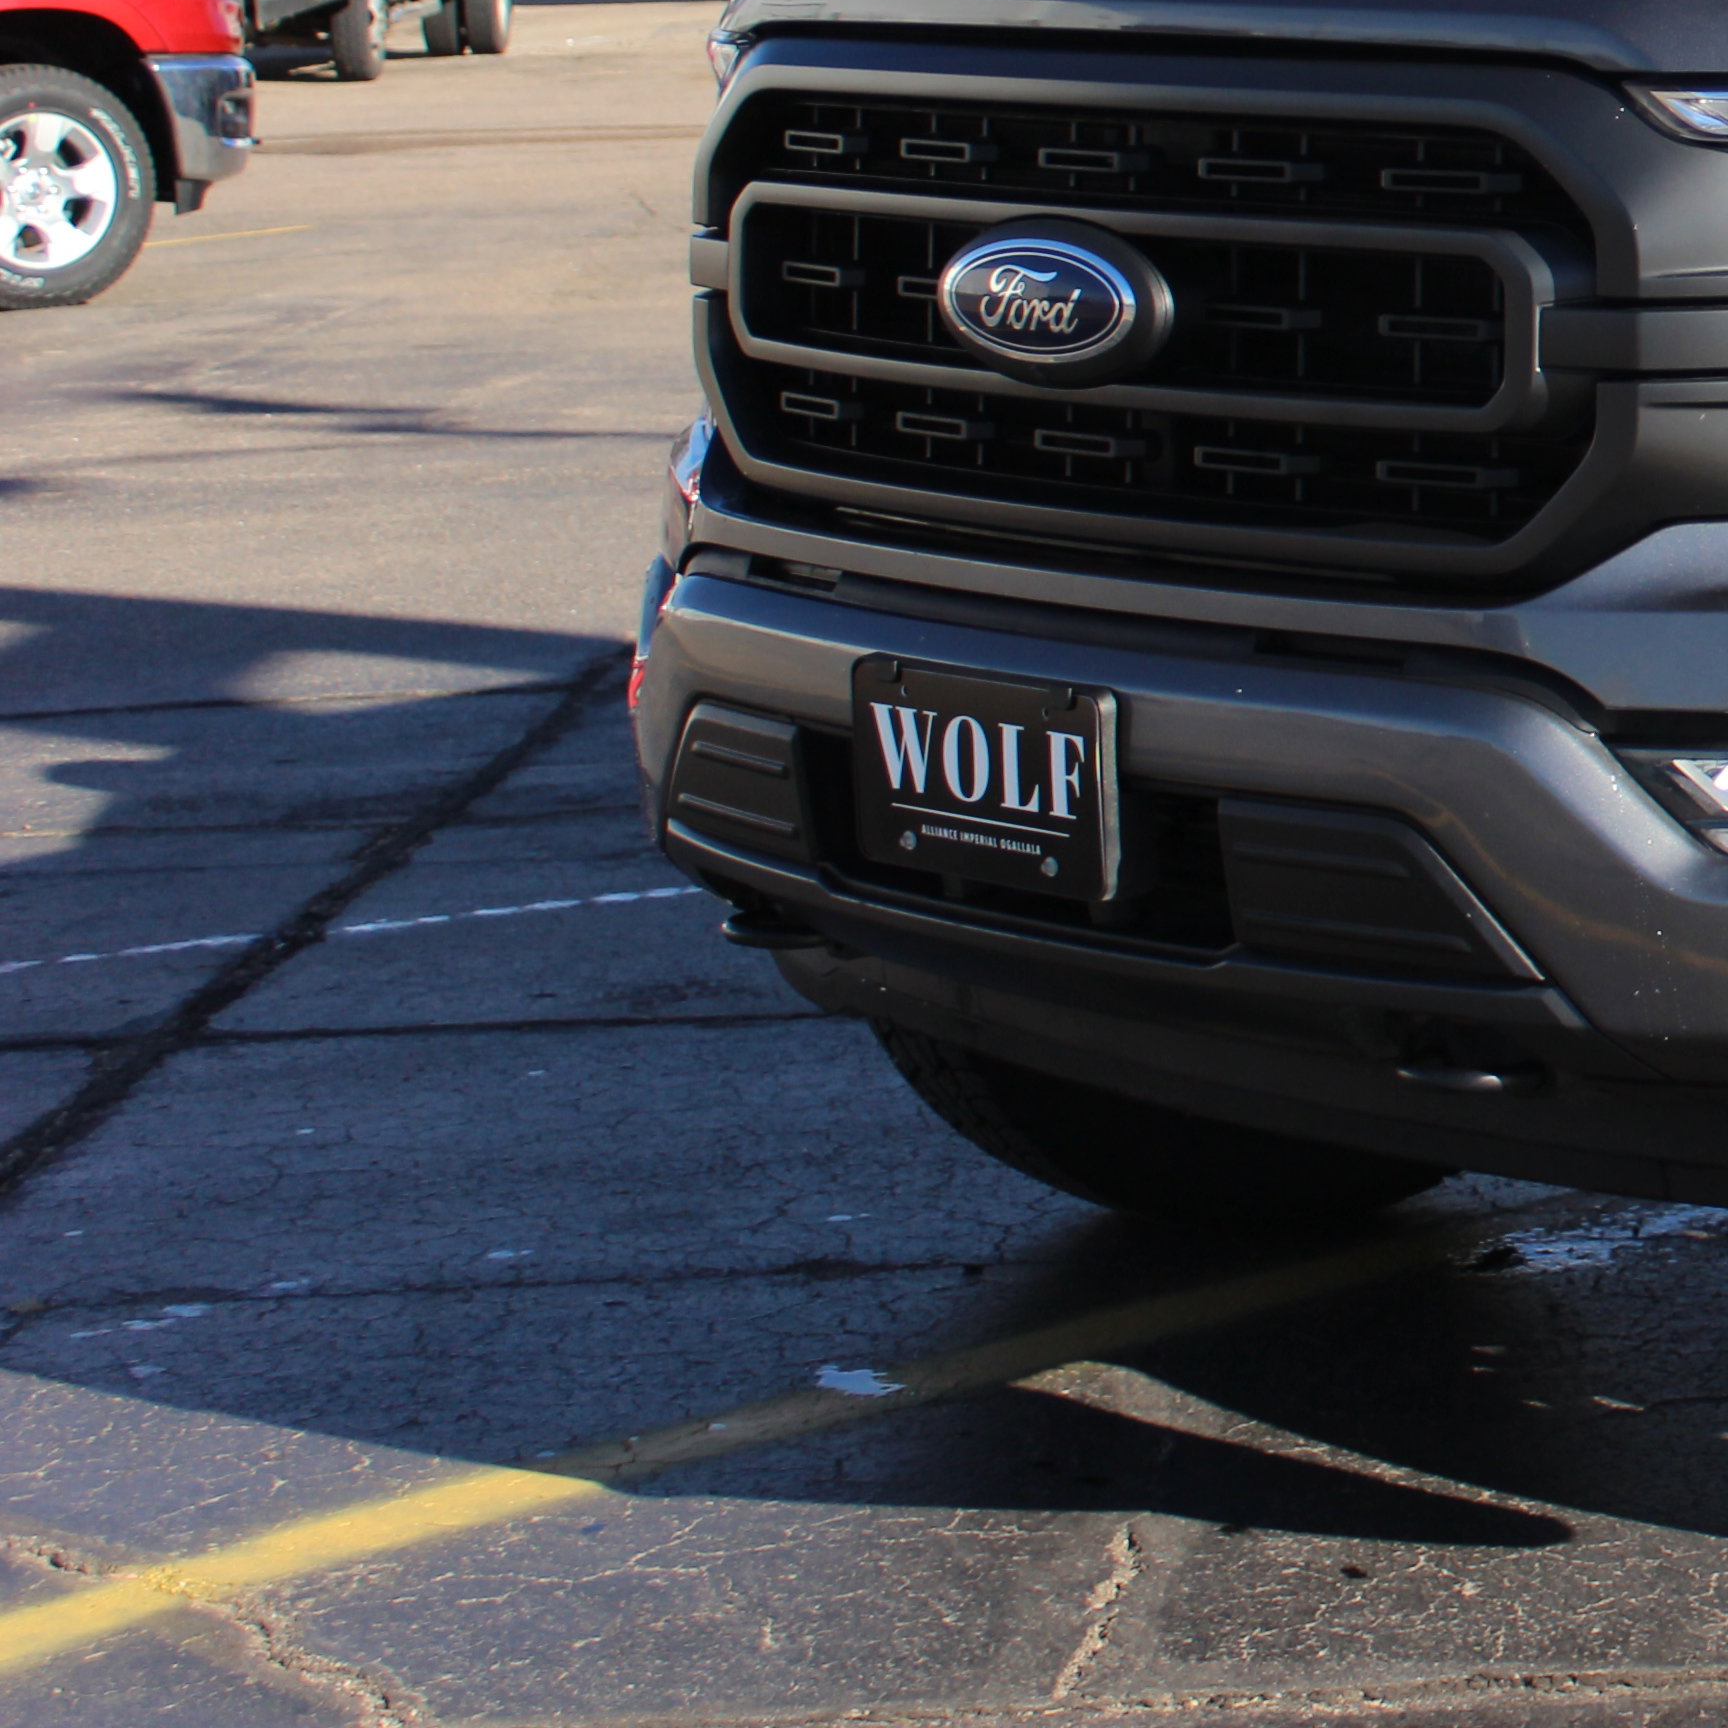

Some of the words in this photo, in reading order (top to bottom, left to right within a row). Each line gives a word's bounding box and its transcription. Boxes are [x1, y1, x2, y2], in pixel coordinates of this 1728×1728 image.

[980, 264, 1082, 334] Ford
[869, 701, 1085, 820] WOLF
[921, 824, 958, 840] ALLIANCE
[960, 831, 998, 848] IMPERIAL
[1000, 838, 1041, 855] OGALLALA
